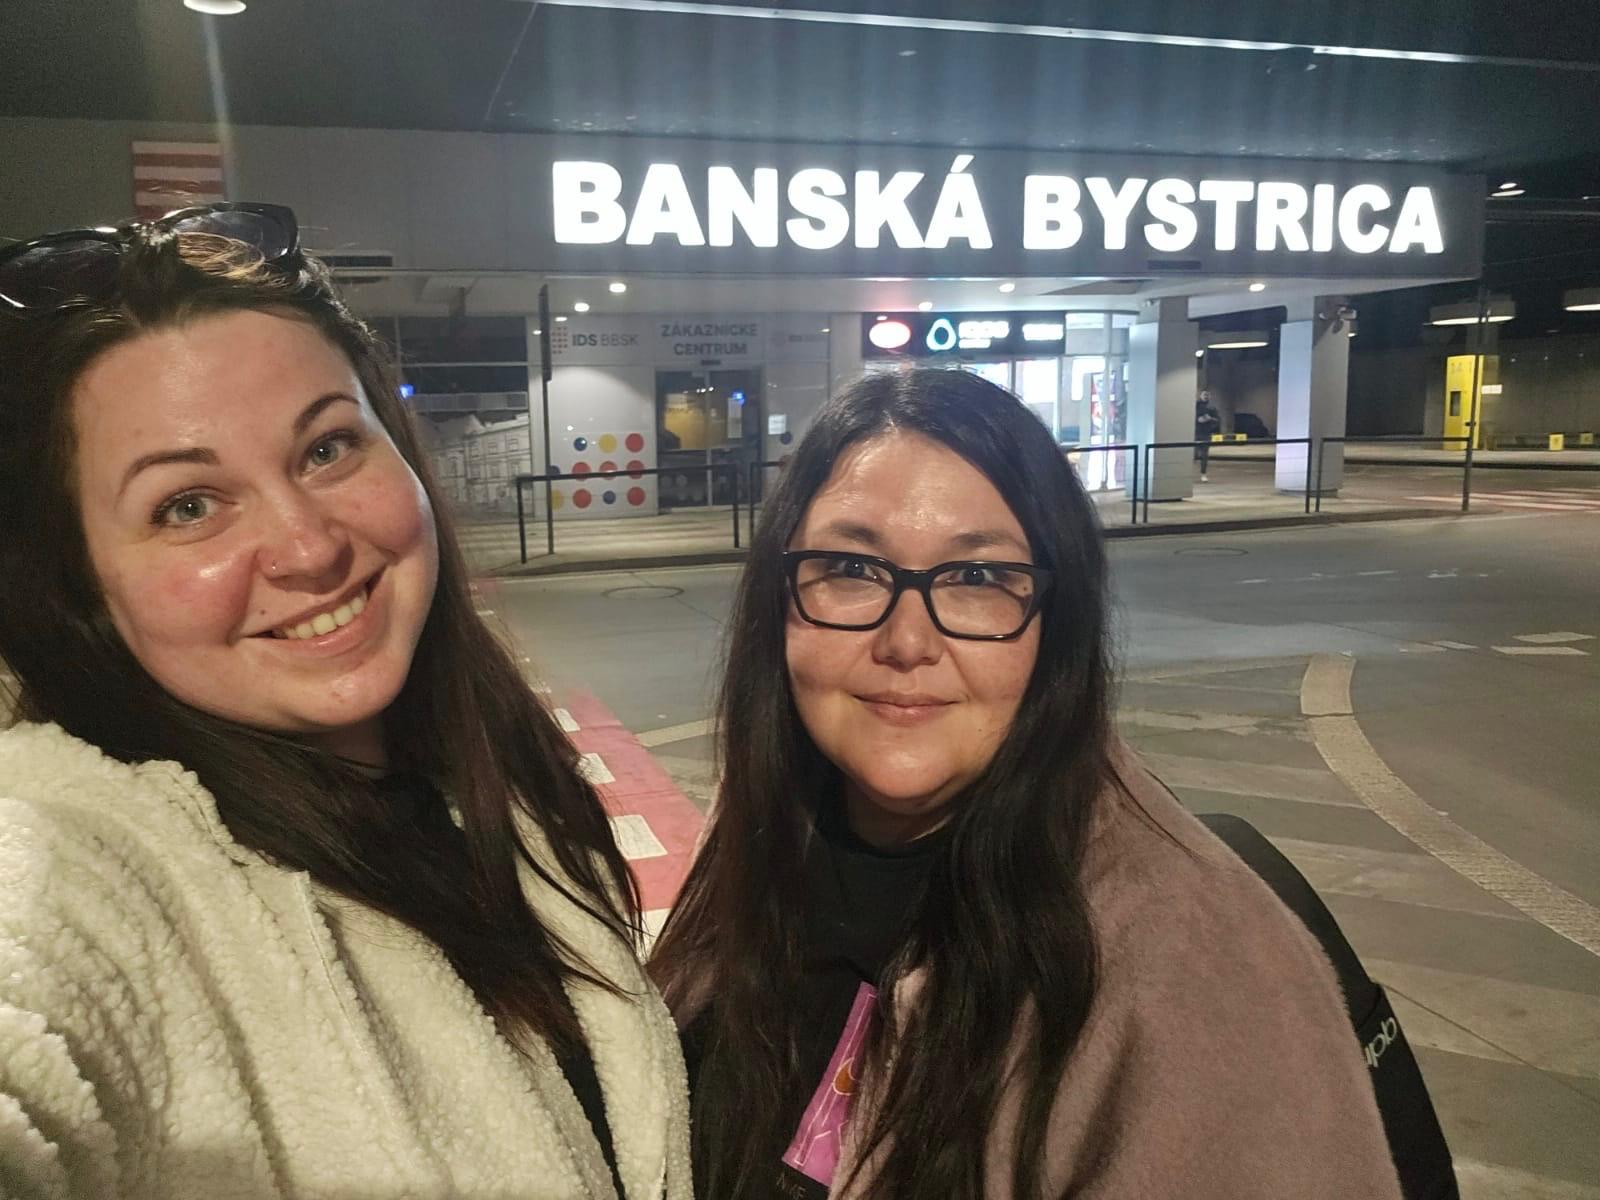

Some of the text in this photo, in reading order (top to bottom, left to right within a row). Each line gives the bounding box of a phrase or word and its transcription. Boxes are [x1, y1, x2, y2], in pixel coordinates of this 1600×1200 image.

[551, 155, 1445, 255] BANSKÁ BYSTRICA
[572, 334, 639, 346] IDS BBSK
[674, 342, 747, 355] CENTRUM
